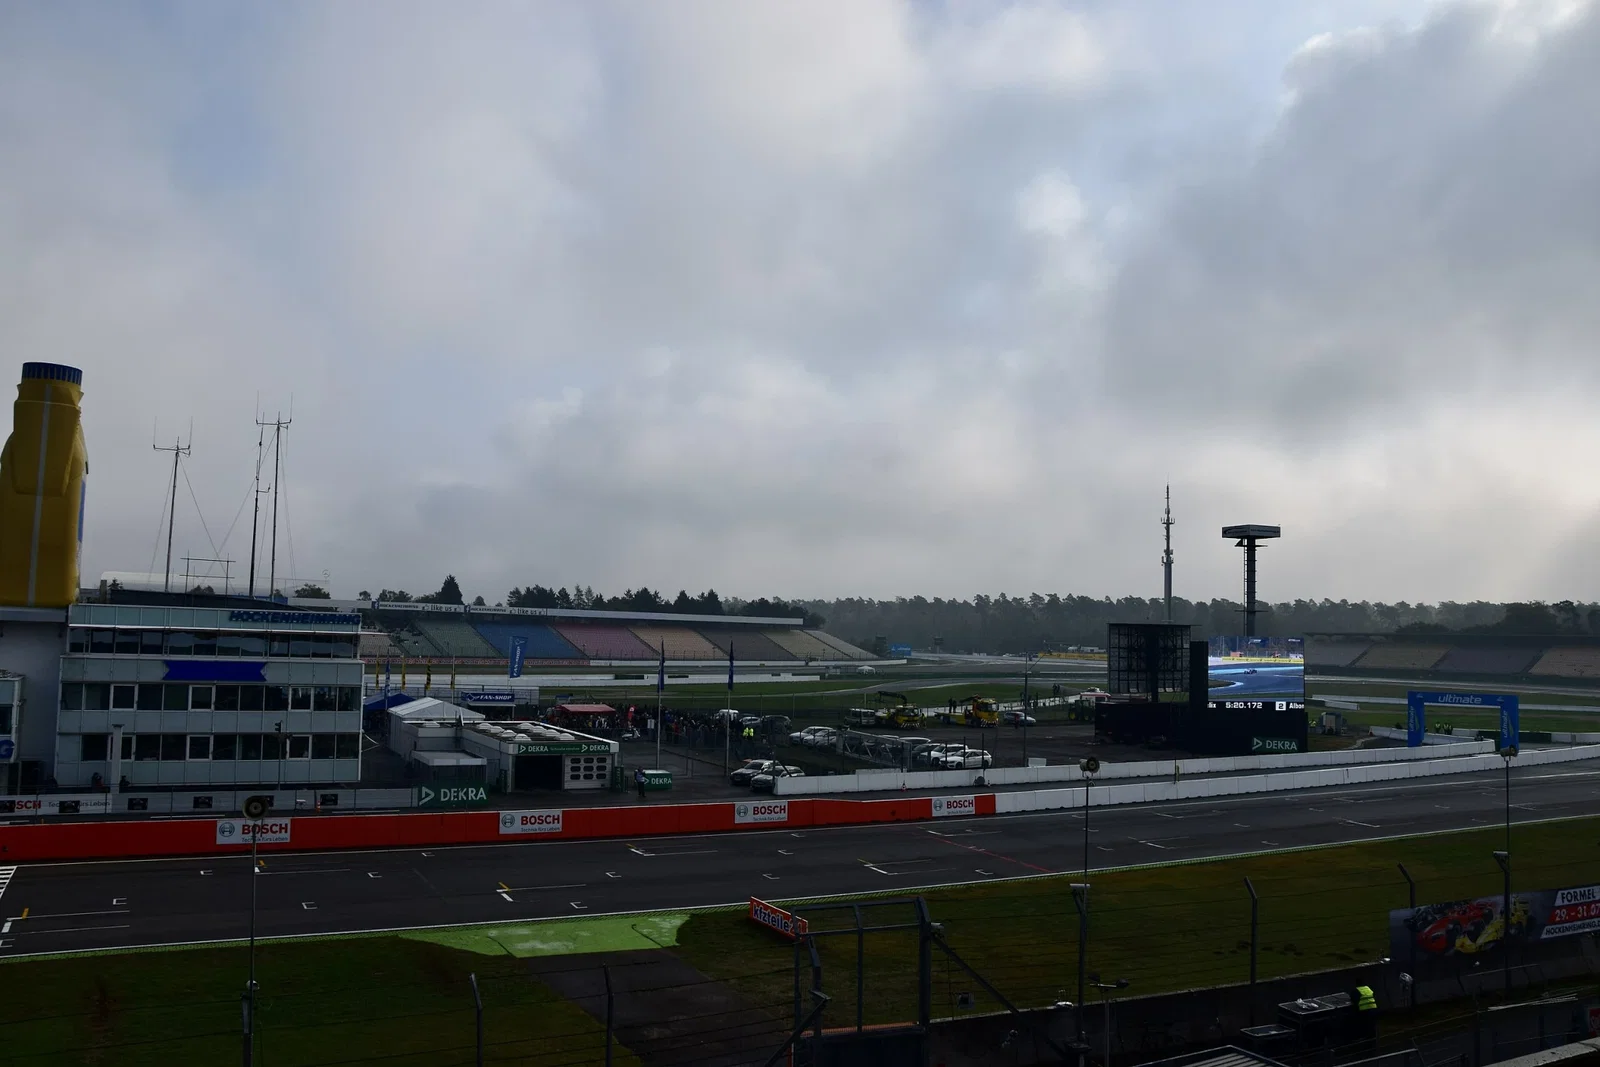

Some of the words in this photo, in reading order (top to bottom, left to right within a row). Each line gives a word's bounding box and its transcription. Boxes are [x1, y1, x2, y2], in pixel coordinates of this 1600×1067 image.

[1438, 693, 1483, 704] ultimate
[1225, 701, 1263, 709] 5:20.172
[1265, 739, 1298, 750] DEKRA
[651, 777, 673, 785] DEKRA
[440, 787, 487, 802] DEKRA
[946, 799, 974, 809] BOSCH
[753, 805, 786, 815] BOSCH
[521, 814, 560, 825] BOSCH
[242, 823, 288, 835] BOSCH
[1561, 888, 1596, 904] FORMEL
